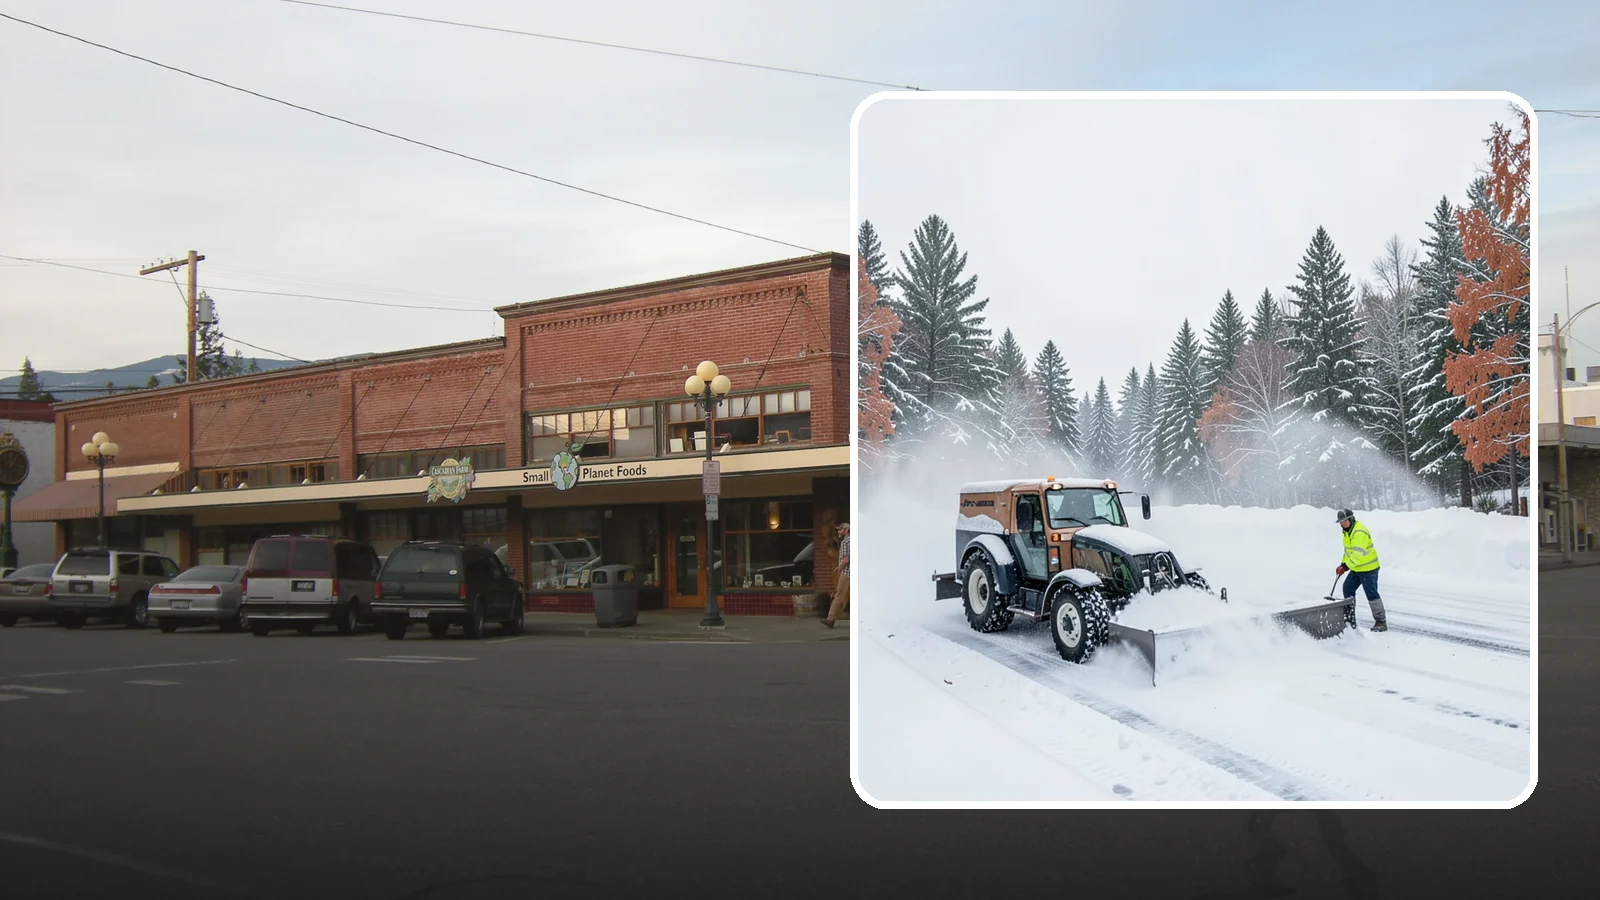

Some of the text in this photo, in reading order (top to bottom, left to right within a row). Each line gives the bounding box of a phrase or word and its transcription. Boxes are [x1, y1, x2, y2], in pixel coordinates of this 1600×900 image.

[523, 464, 647, 482] Small Planet Foods
